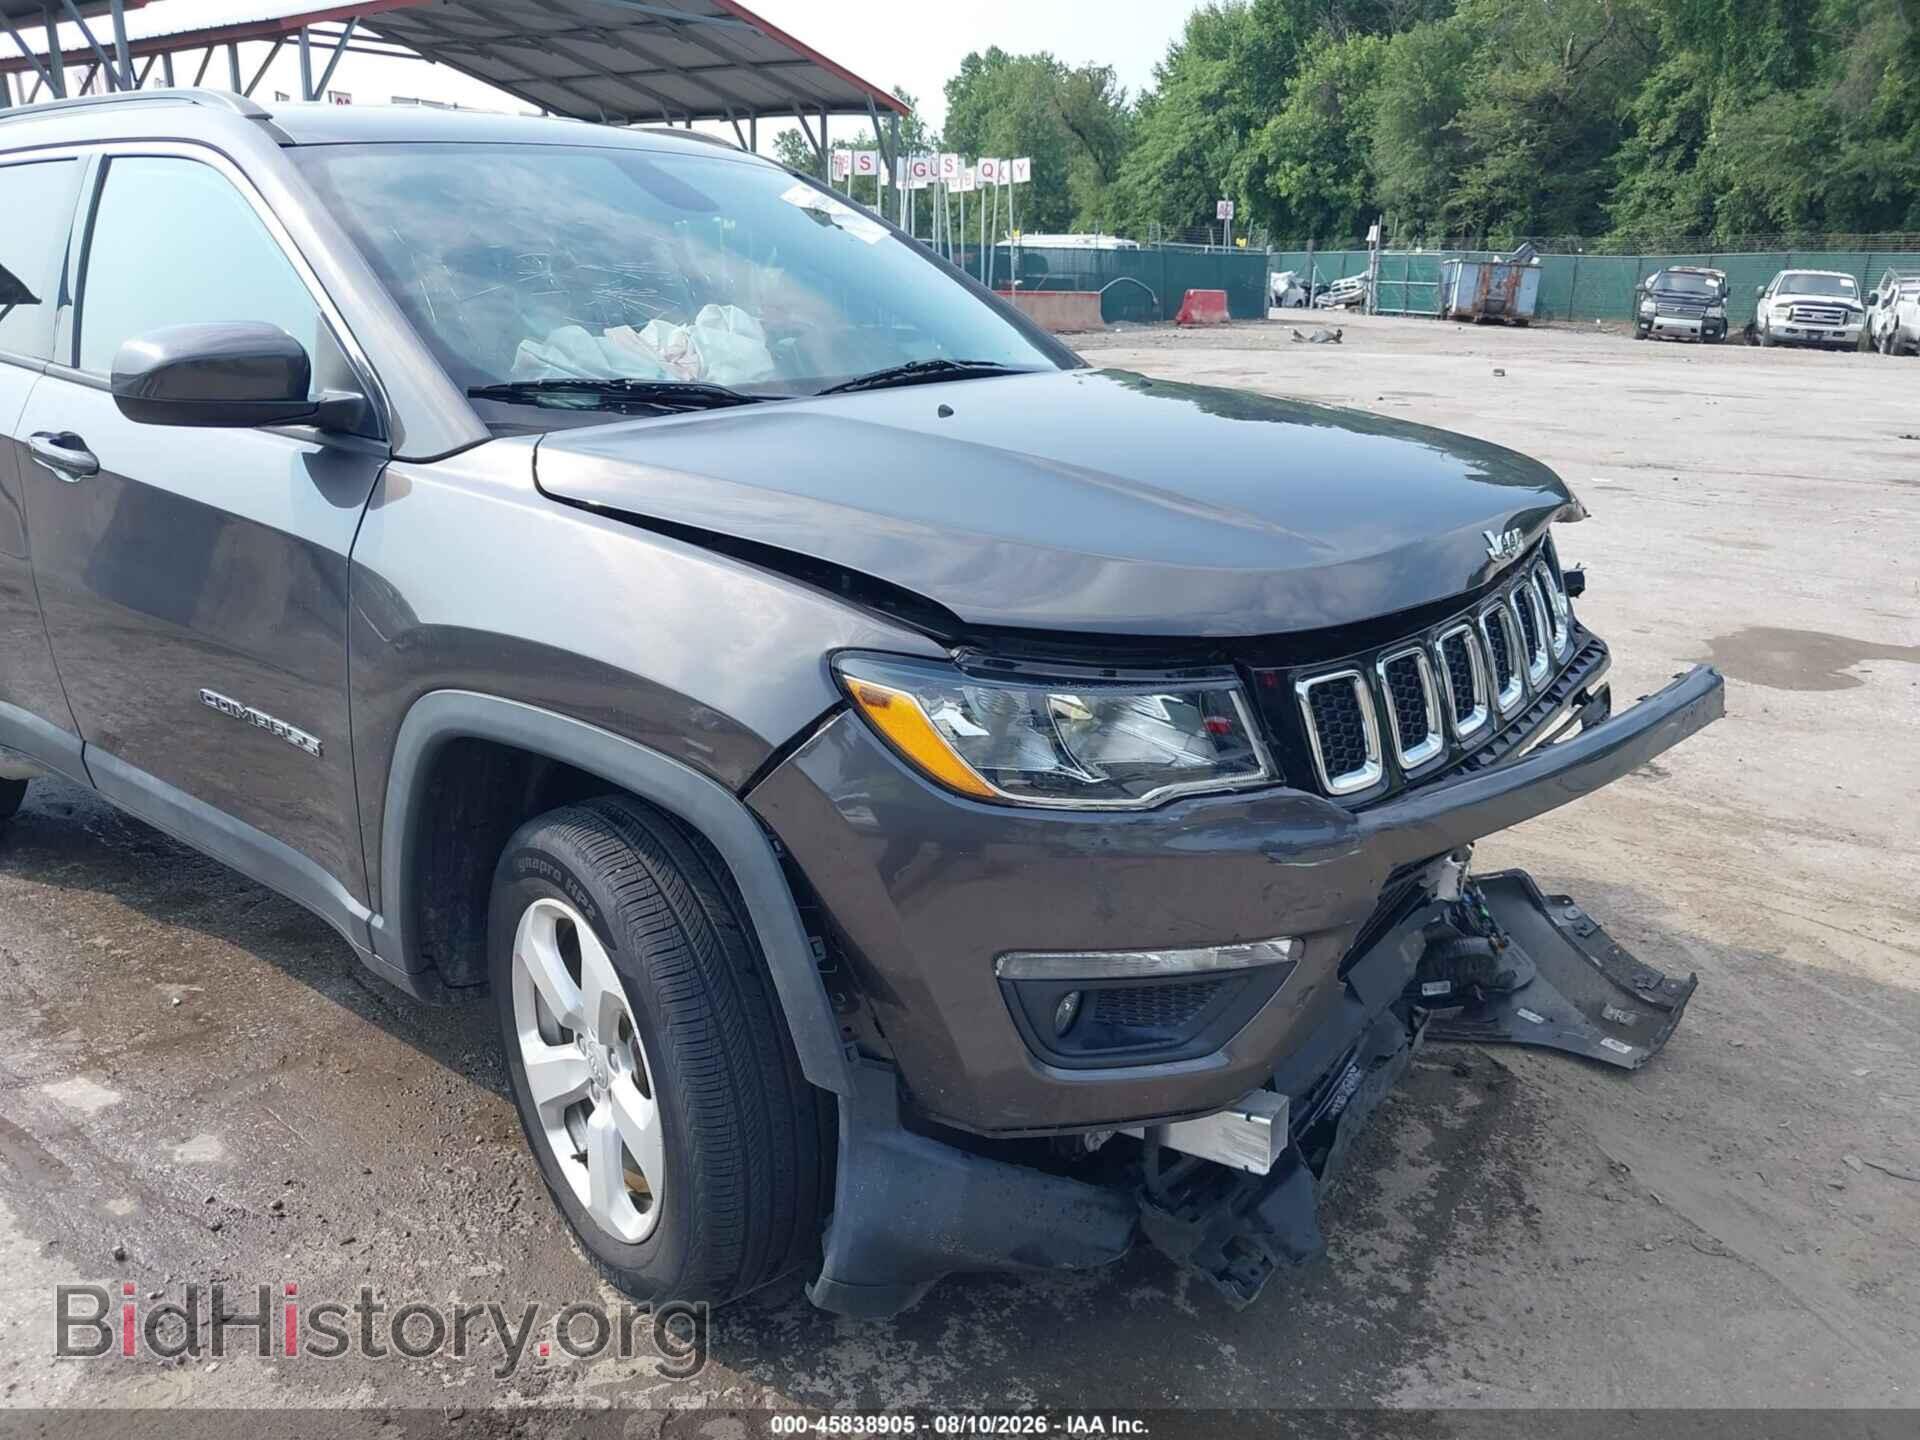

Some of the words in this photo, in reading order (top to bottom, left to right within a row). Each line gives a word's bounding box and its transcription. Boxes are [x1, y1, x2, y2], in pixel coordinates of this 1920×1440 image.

[860, 155, 871, 170] S
[913, 162, 926, 177] G
[944, 158, 953, 173] S
[982, 163, 993, 178] Q
[1016, 163, 1025, 179] Y
